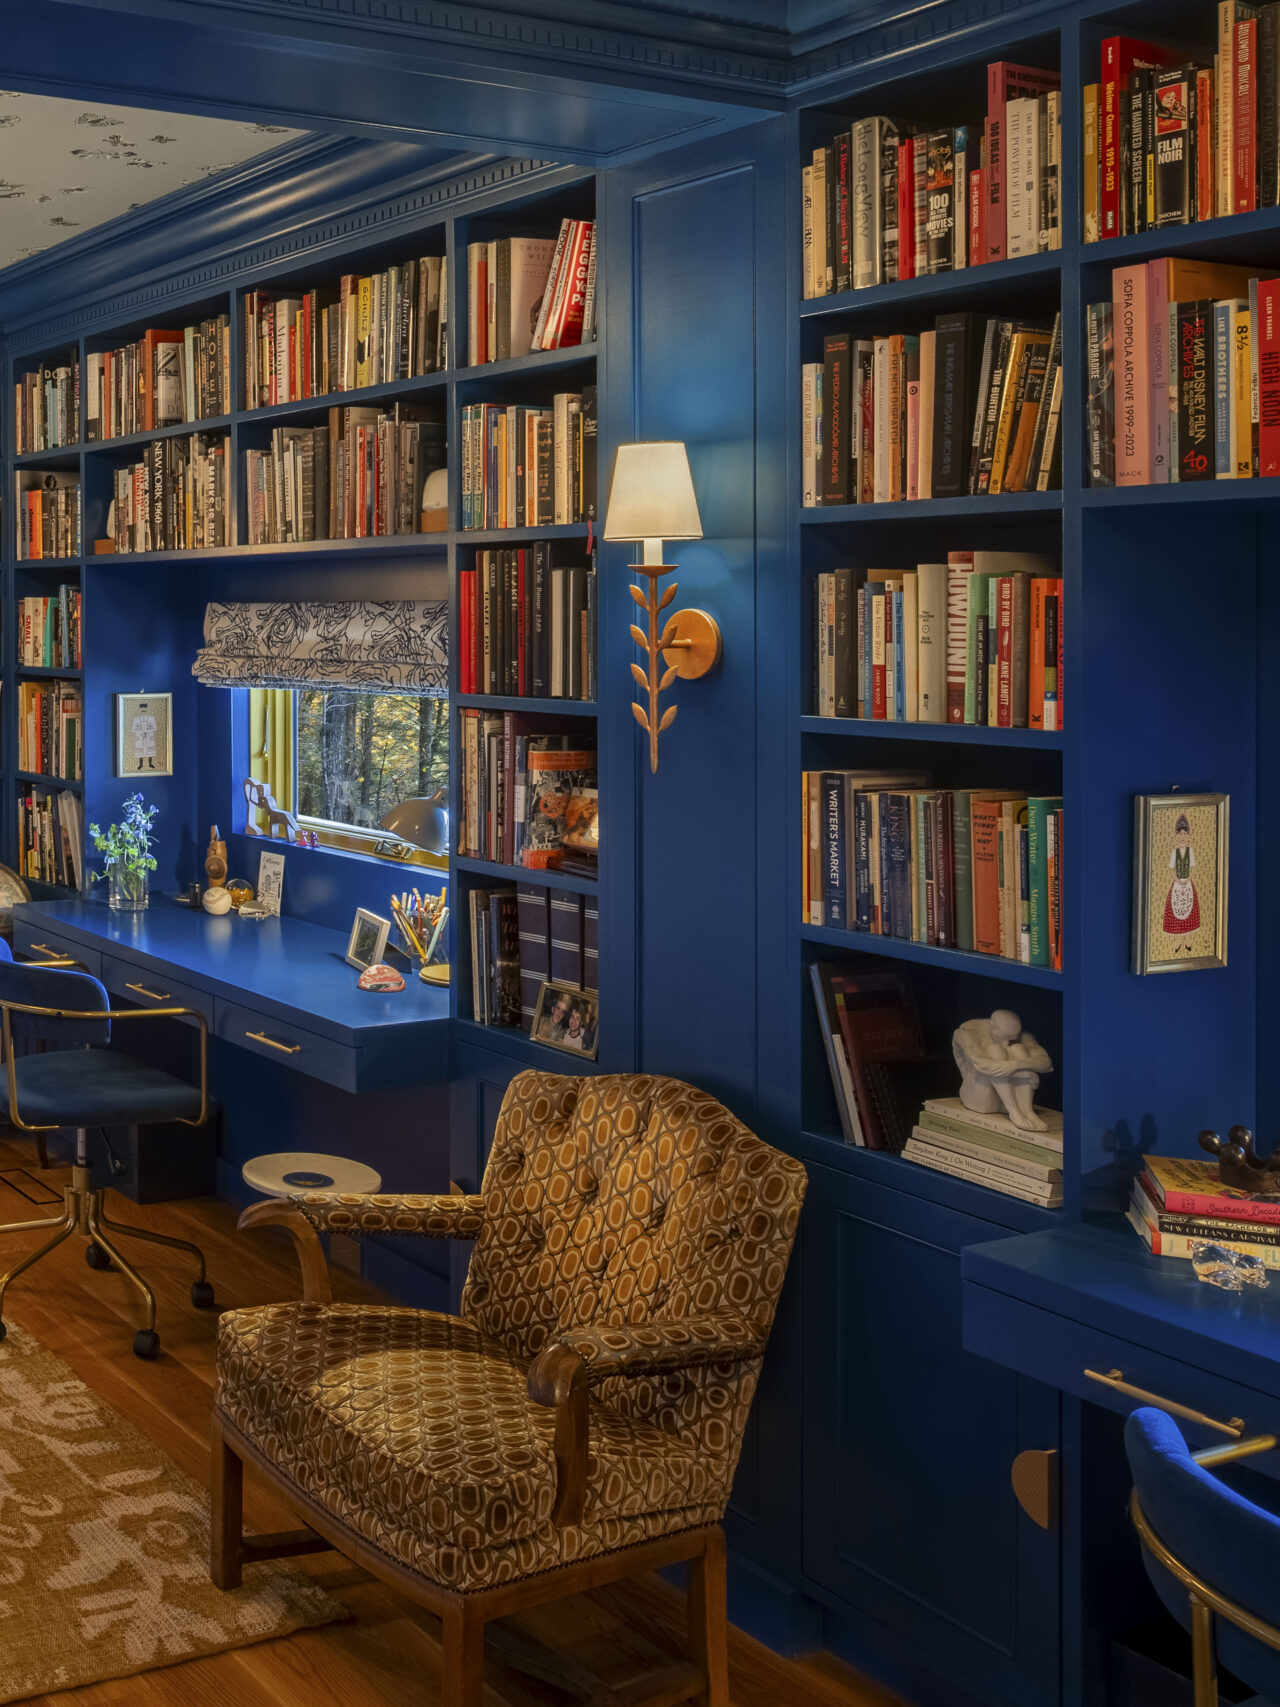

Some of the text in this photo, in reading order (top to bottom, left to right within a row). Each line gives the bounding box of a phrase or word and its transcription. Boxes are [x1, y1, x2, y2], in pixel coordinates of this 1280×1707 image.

[1222, 43, 1231, 64] THE
[1238, 24, 1250, 62] HOLLYWOOD
[1238, 65, 1249, 96] MUSICALS
[1106, 82, 1114, 112] Weimar
[1105, 115, 1114, 145] Cinema,
[1132, 93, 1142, 182] THE HAUNTED SCREEN
[1157, 137, 1183, 152] FILM
[839, 153, 848, 184] History
[990, 122, 1000, 204] 100 IDEAS FILM
[1011, 113, 1020, 218] THE POWER OF FILM
[1157, 151, 1183, 165] NOIR
[929, 193, 948, 210] 100
[1124, 280, 1132, 308] SOFIA
[1124, 311, 1133, 357] COPPOLA
[1020, 351, 1030, 376] Cocteau
[1091, 344, 1099, 378] PARADISE
[1183, 322, 1193, 378] ARCHIVES
[1194, 338, 1205, 366] WALT
[1218, 317, 1226, 398] LIKE BROTHERS
[1019, 378, 1026, 386] on
[1125, 360, 1133, 401] ARCHIVE
[1262, 352, 1279, 384] HIGH
[890, 354, 899, 444] FRENCH DISPATCH
[988, 369, 1003, 421] TIM BURTON
[1016, 398, 1024, 410] Film
[1194, 370, 1205, 410] DISNEY
[1263, 391, 1280, 427] NOON
[1194, 415, 1206, 444] FILM
[831, 449, 839, 483] ARCHIVES
[947, 564, 972, 682] HOWDUNIT
[1001, 611, 1009, 626] BIRD
[1001, 661, 1009, 678] ANNE
[1001, 680, 1009, 705] LAMOTT
[829, 790, 839, 886] WRITER'S MARKET
[890, 806, 898, 842] KING
[1030, 889, 1039, 923] Maggie
[1032, 926, 1040, 954] Smith
[913, 1144, 985, 1174] Stephen King On Writing
[1206, 1203, 1248, 1214] Southern
